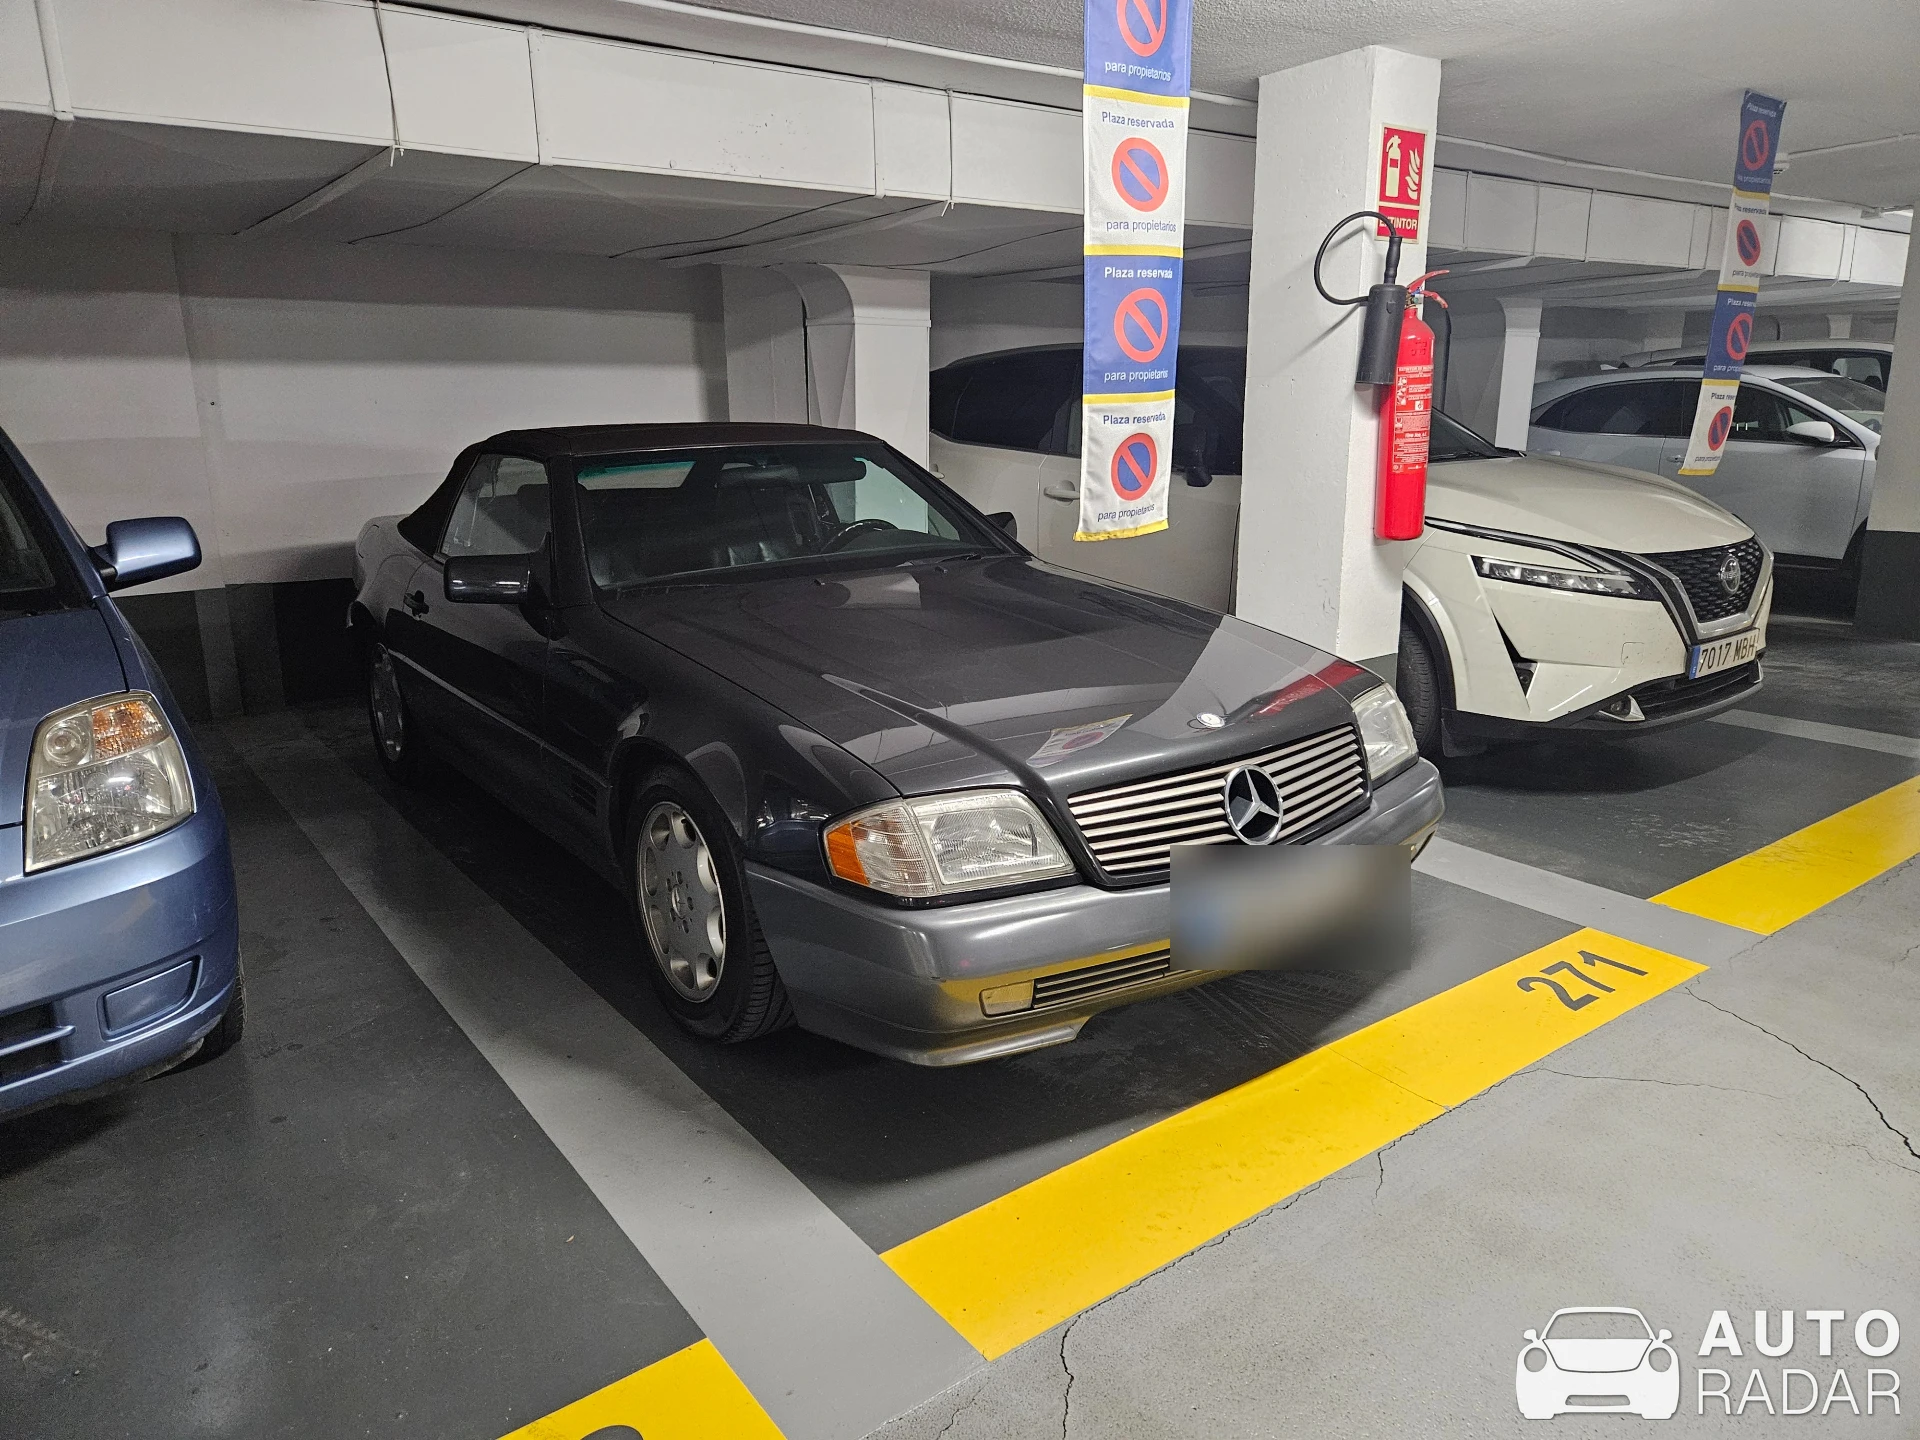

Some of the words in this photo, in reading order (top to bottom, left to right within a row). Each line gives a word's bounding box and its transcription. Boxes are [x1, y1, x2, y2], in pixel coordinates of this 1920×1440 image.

[1104, 61, 1127, 74] para
[1128, 63, 1172, 82] propietarios
[1101, 111, 1126, 125] Plaza
[1127, 115, 1175, 129] reservada
[1106, 220, 1129, 232] para
[1132, 219, 1177, 233] propietarios
[1379, 216, 1418, 231] ETINTOR
[1104, 266, 1134, 279] Plaza
[1104, 371, 1126, 383] para
[1103, 414, 1130, 425] Plaza
[1132, 411, 1166, 425] reservada
[1097, 511, 1117, 522] para
[1118, 503, 1155, 520] propietarios
[1698, 642, 1733, 673] 7017
[1733, 634, 1757, 662] MBH
[1516, 950, 1649, 1012] 271
